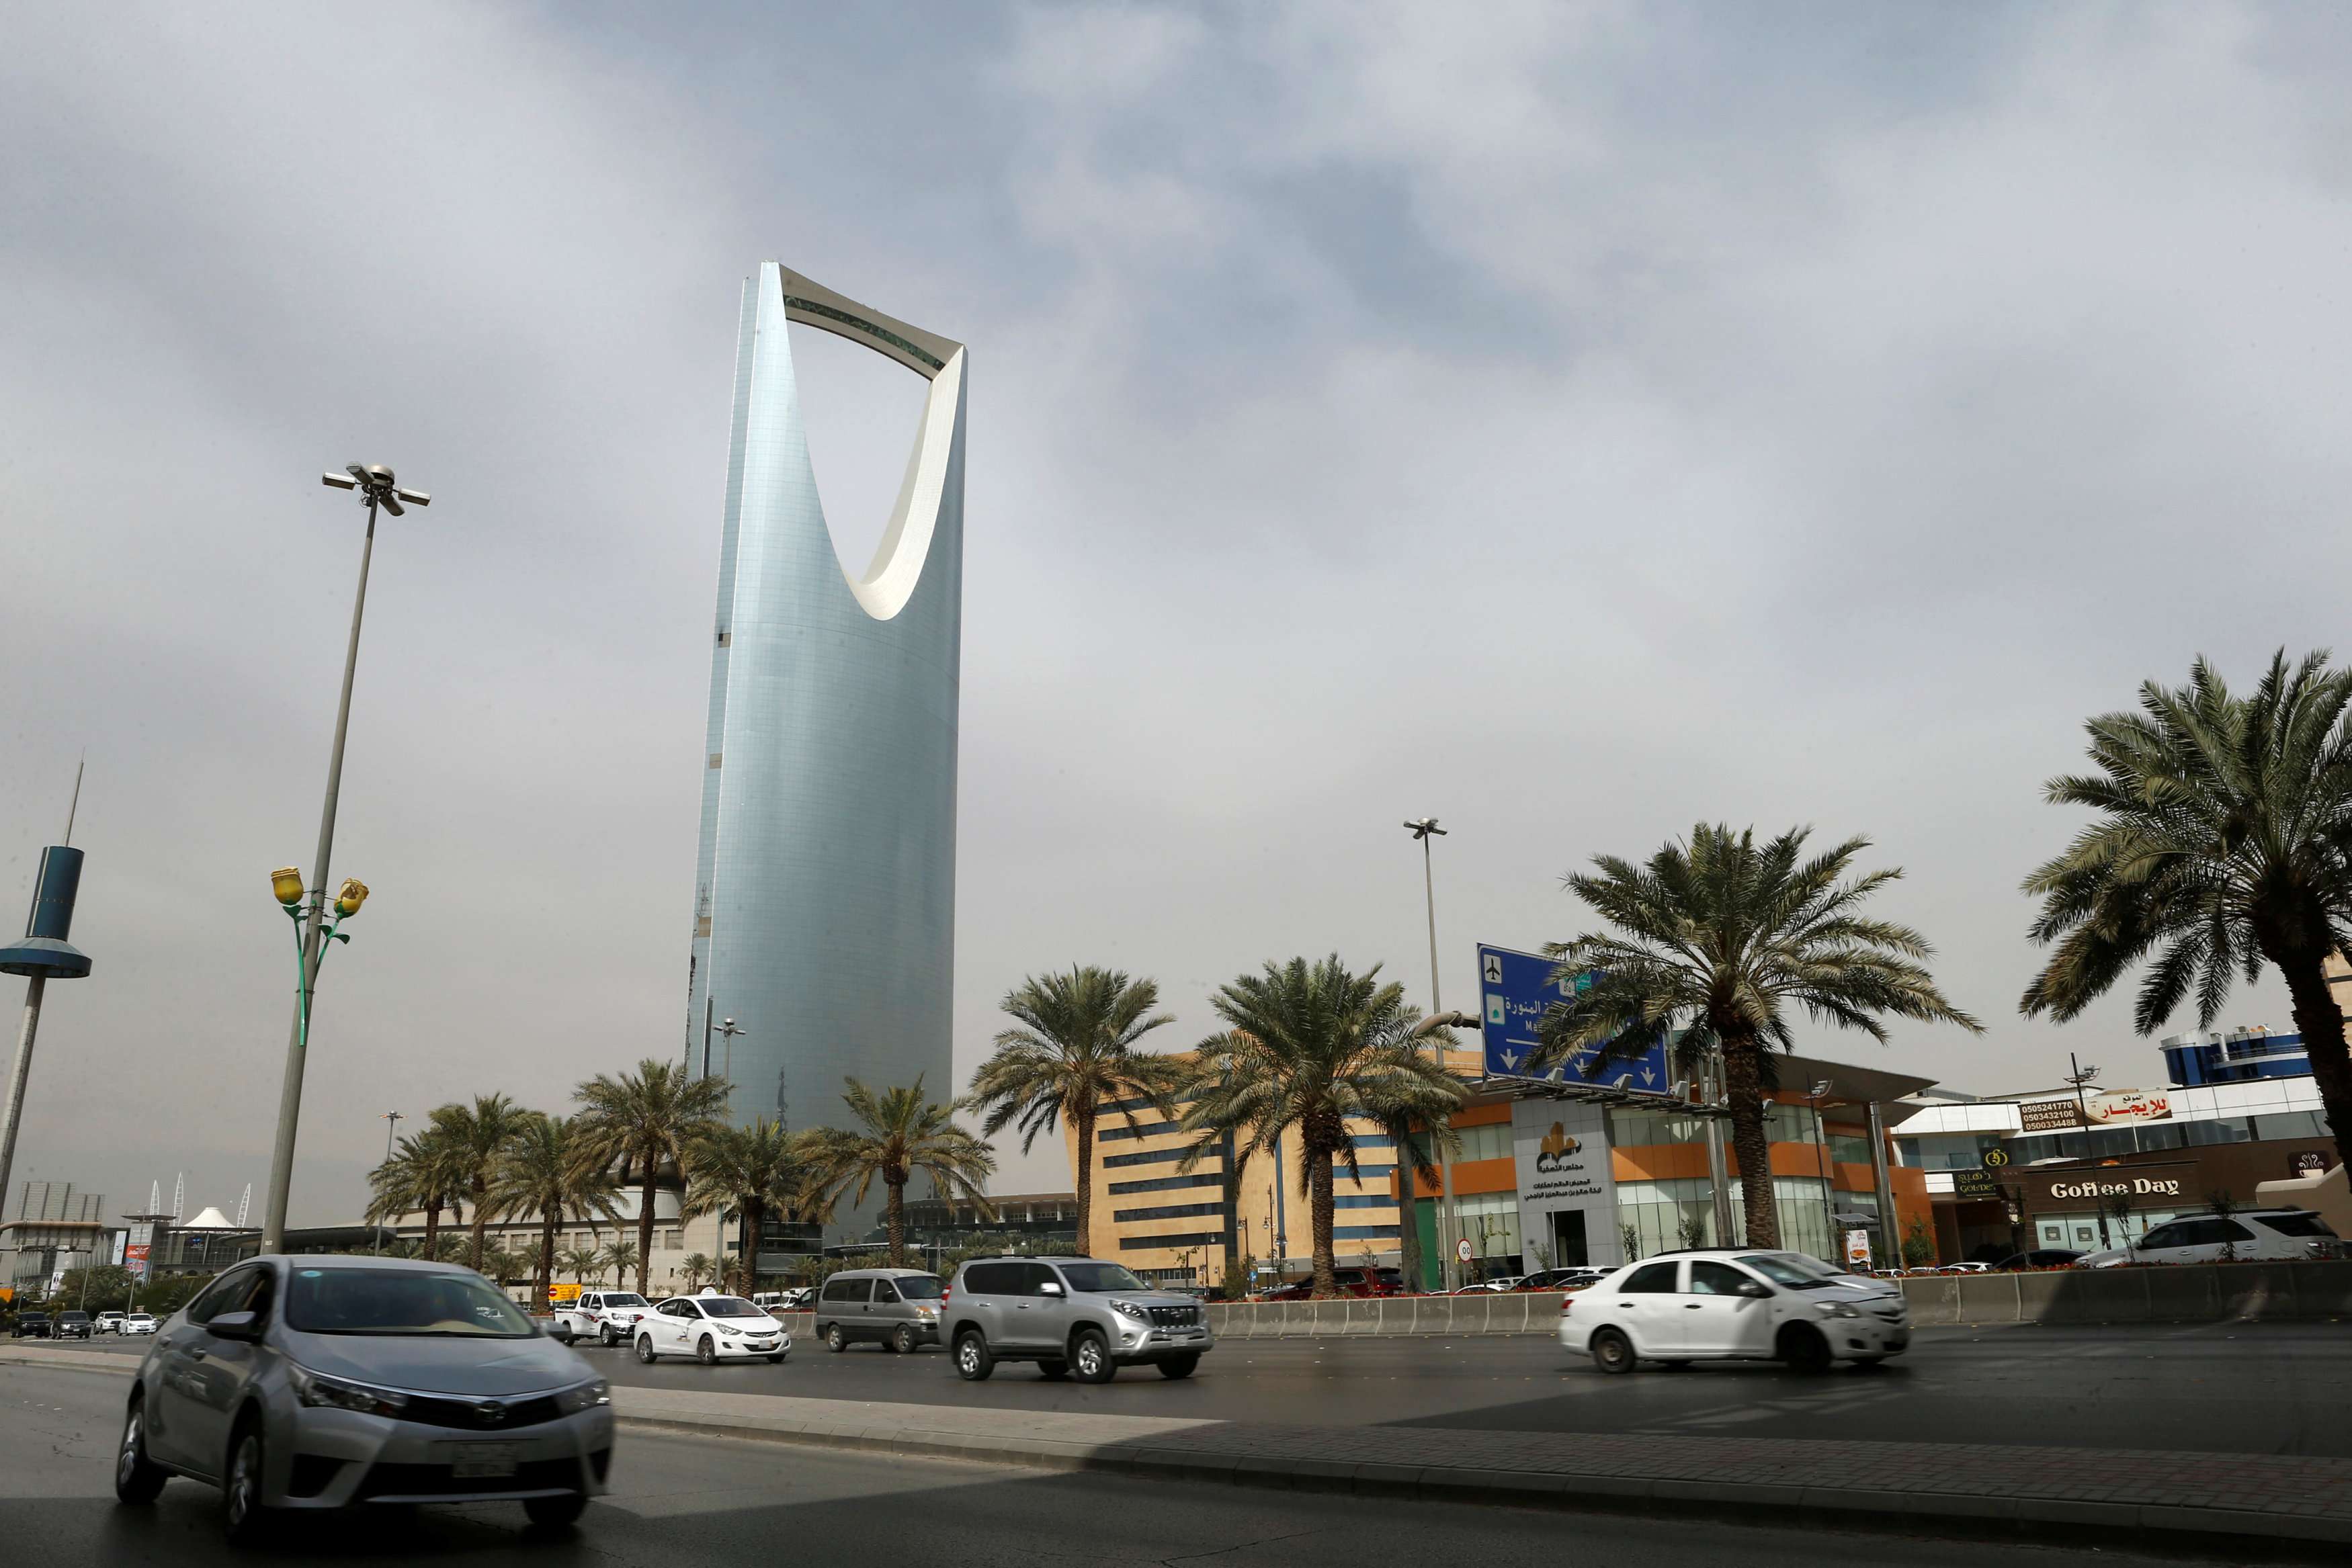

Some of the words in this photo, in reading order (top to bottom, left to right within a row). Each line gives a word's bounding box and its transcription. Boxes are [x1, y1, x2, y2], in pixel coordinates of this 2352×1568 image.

[1505, 997, 1541, 1015] المنورة
[2123, 1095, 2144, 1104] الموقع
[2022, 1102, 2072, 1113] 0505241770
[2023, 1110, 2074, 1121] 0503432100
[2025, 1119, 2076, 1130] 0500334488
[2050, 1181, 2129, 1199] Coffee
[2132, 1178, 2180, 1196] Day
